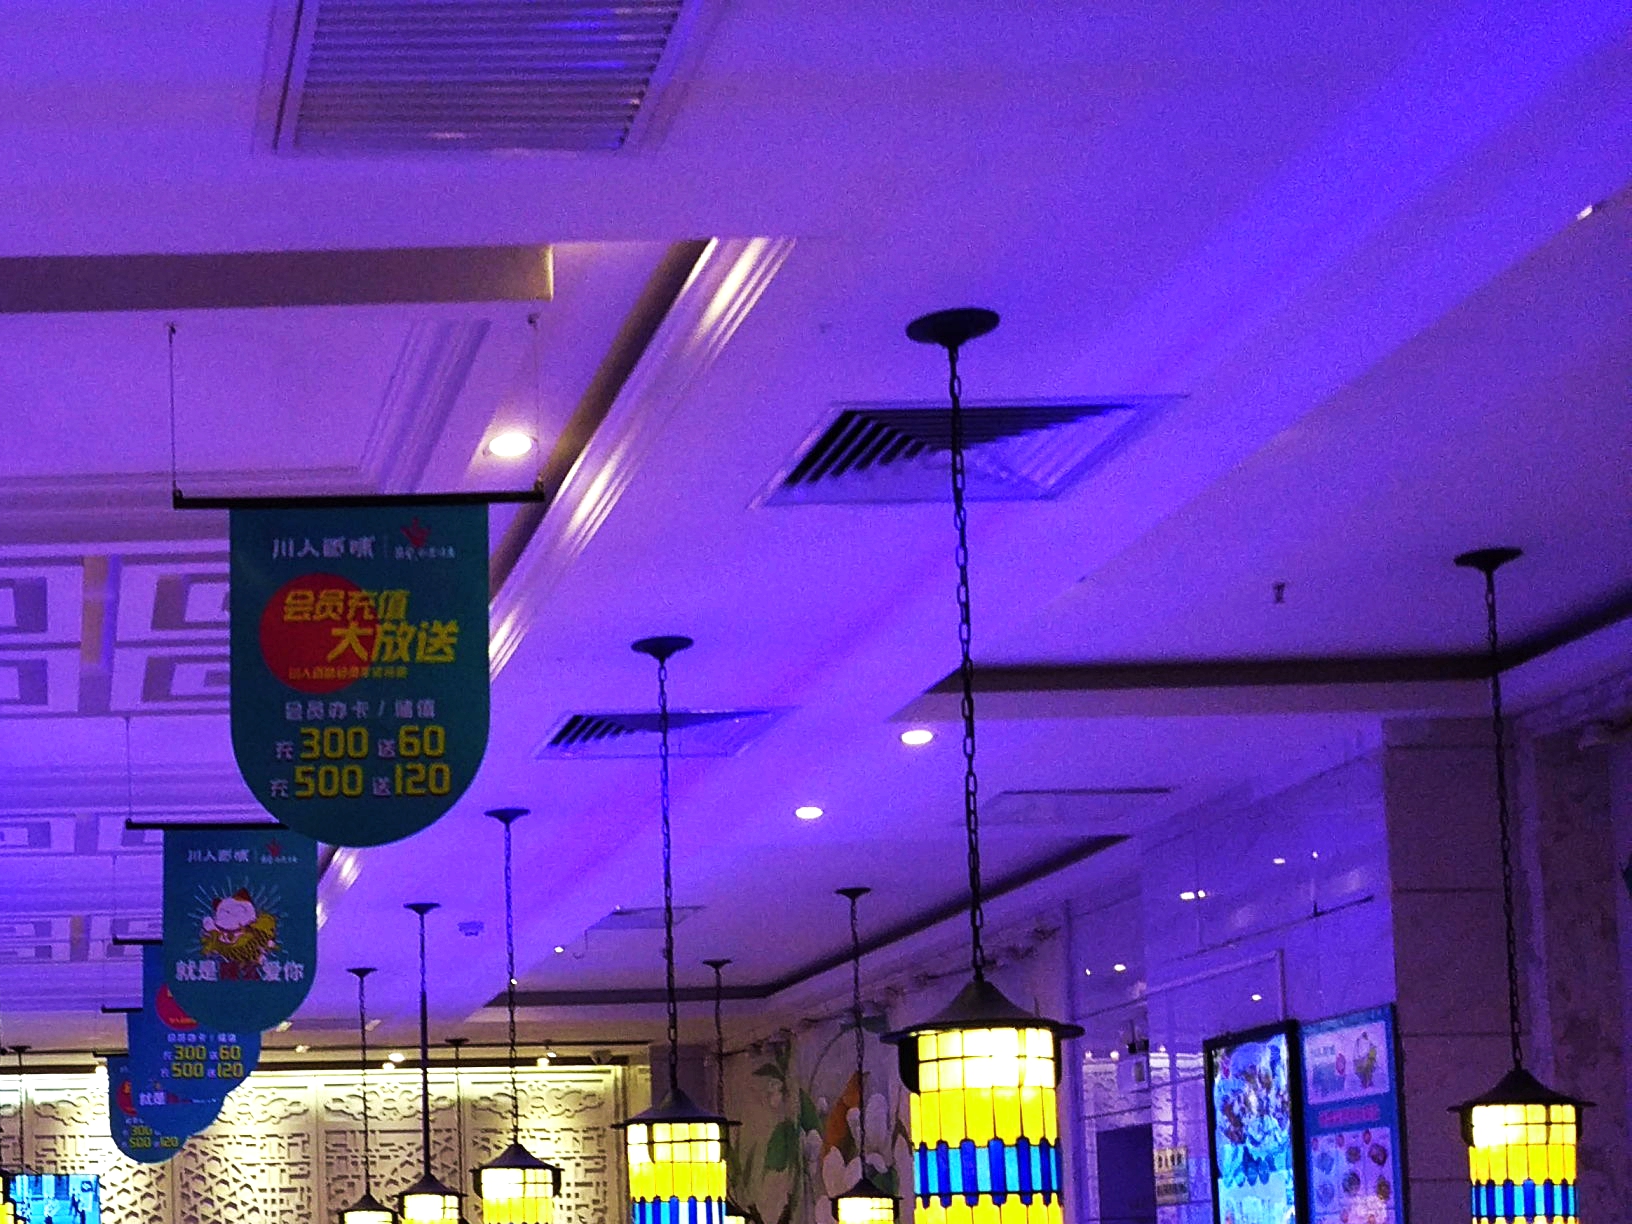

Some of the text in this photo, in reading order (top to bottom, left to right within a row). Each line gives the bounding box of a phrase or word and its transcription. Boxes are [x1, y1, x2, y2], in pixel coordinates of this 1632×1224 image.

[283, 588, 410, 623] 会员充值
[326, 619, 460, 664] 大放送
